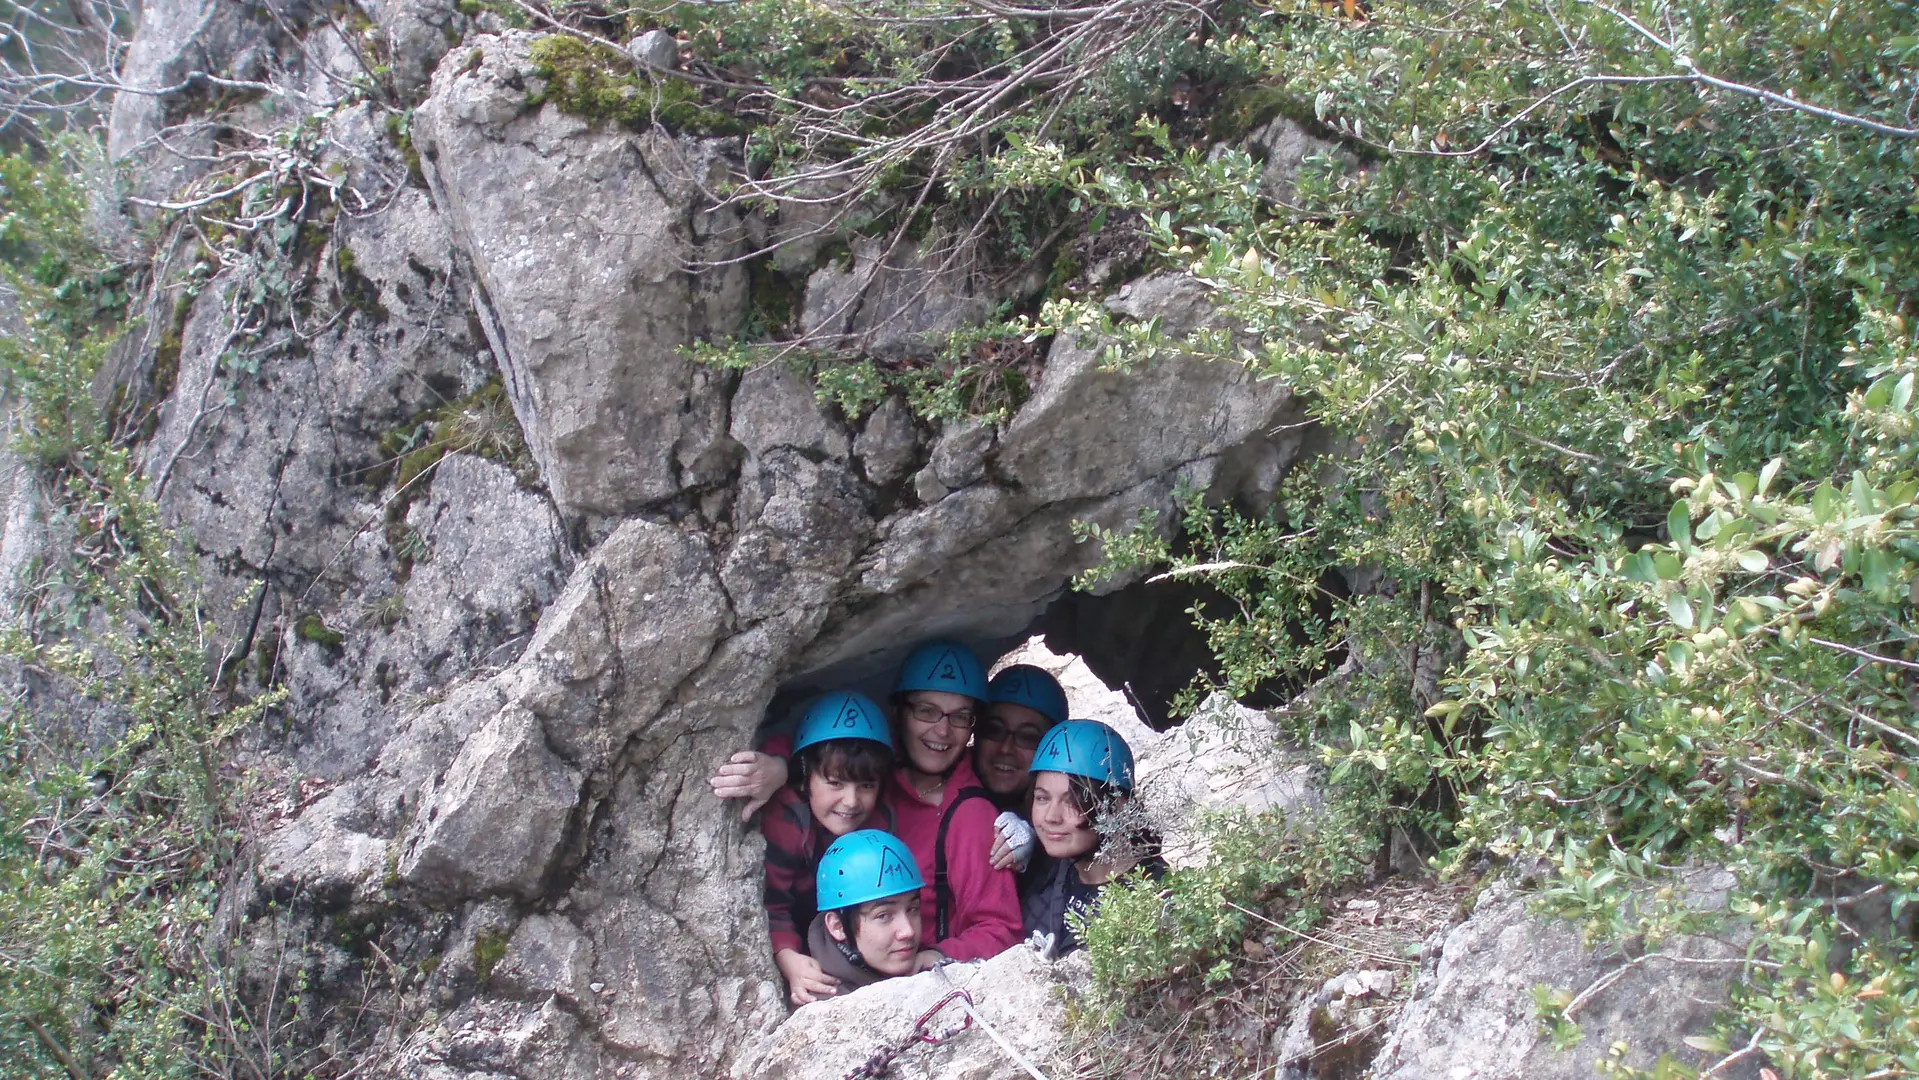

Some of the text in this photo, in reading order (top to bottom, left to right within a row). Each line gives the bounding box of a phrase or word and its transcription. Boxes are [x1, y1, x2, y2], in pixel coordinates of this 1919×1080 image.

[941, 664, 956, 679] 2
[843, 708, 859, 728] 8
[1048, 741, 1060, 760] 4
